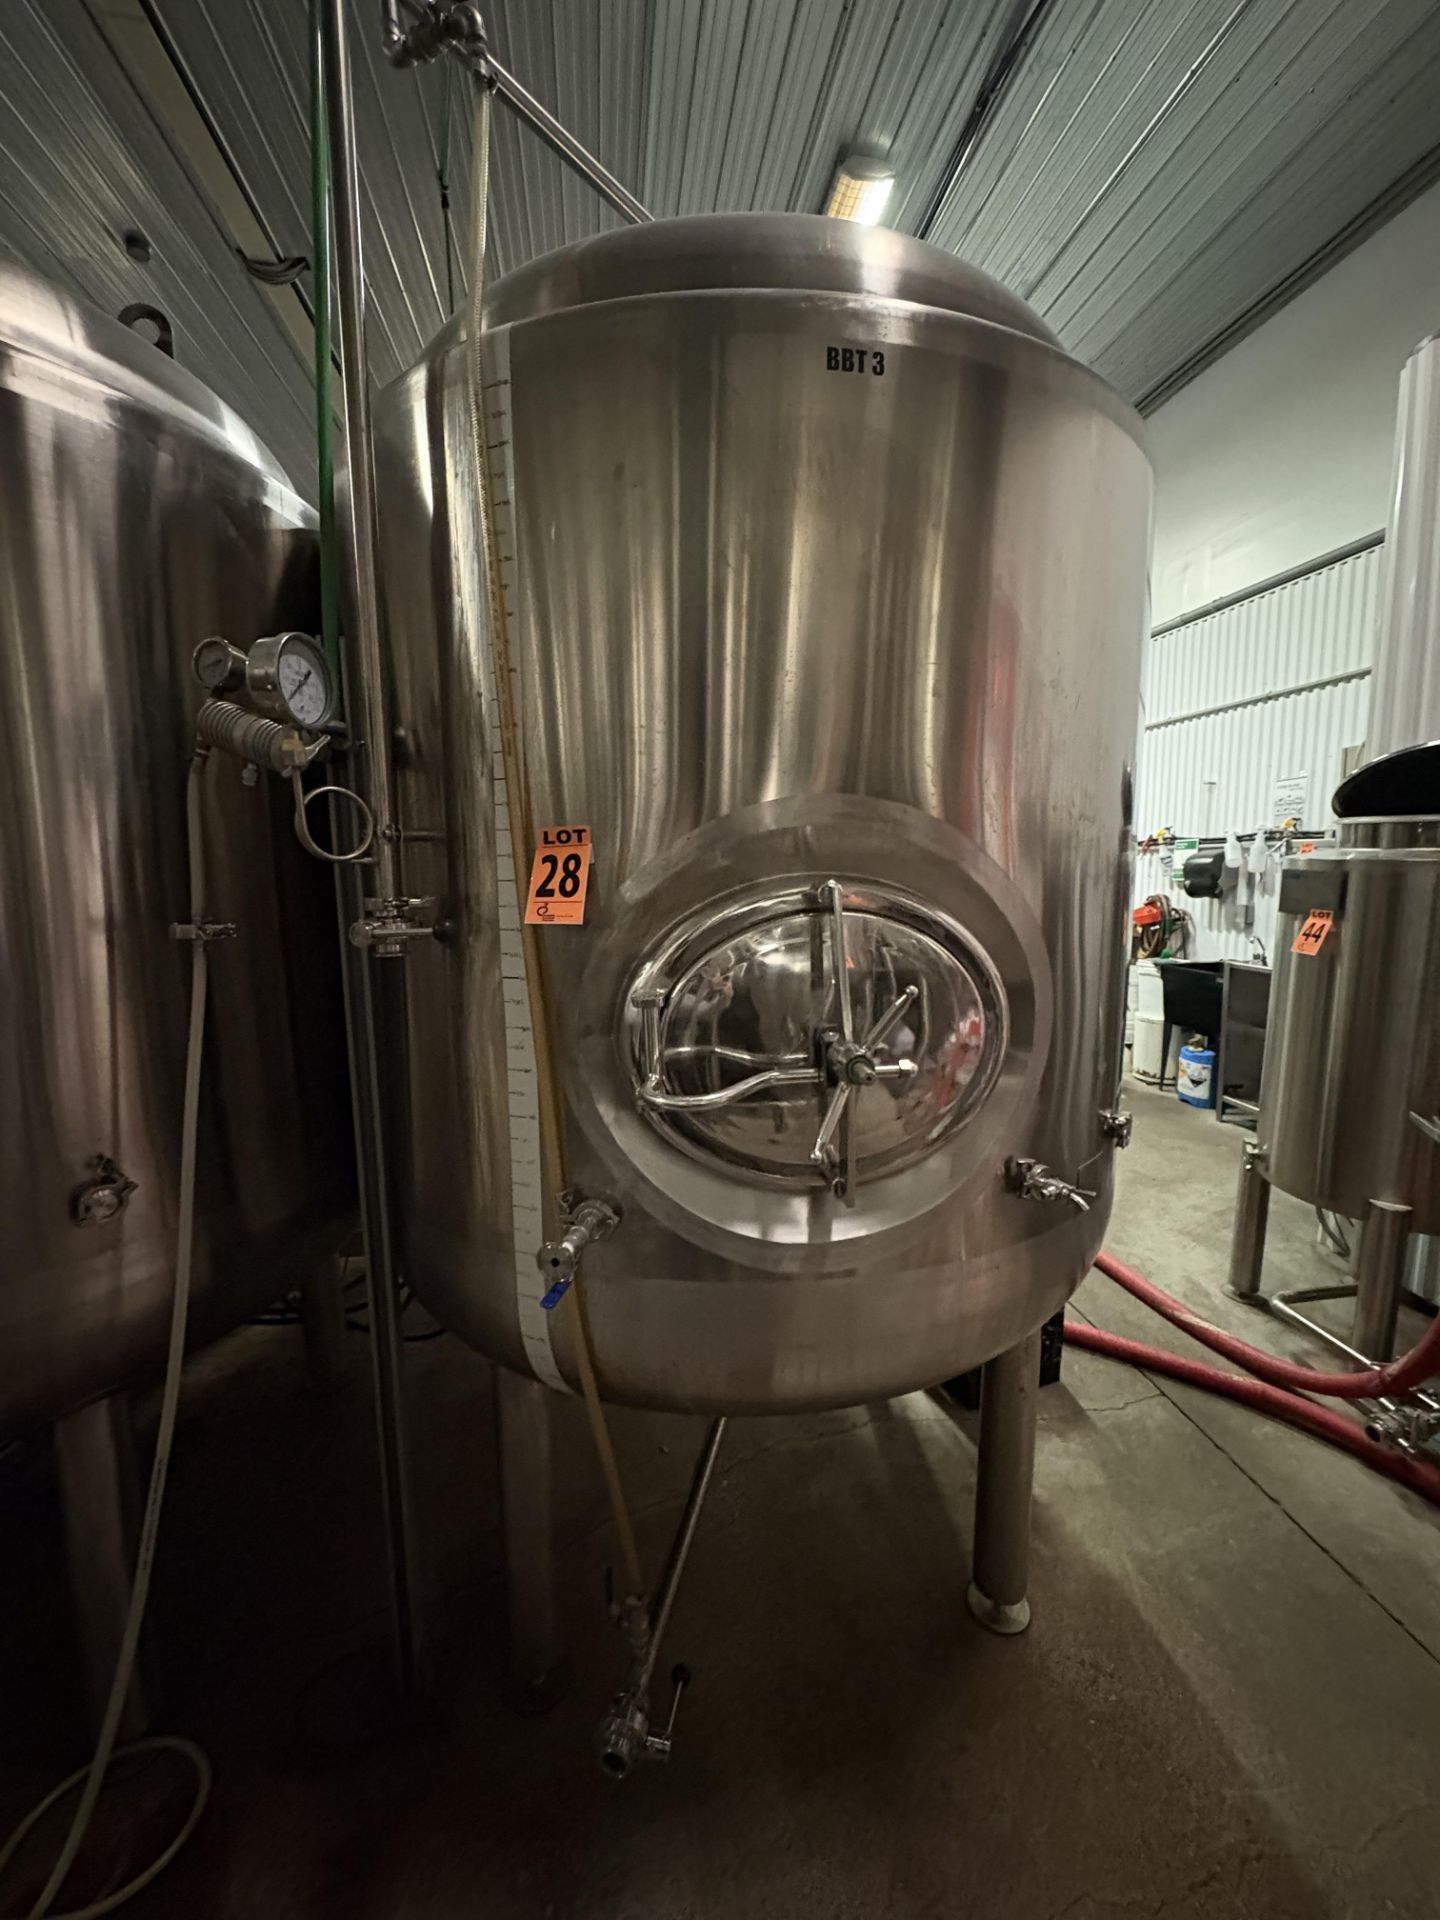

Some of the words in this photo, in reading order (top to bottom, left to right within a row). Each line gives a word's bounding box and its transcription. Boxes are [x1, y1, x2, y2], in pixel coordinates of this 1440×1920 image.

[827, 346, 867, 373] BBT
[872, 351, 885, 376] 3
[543, 829, 586, 845] LOT
[535, 853, 582, 898] 28
[1312, 911, 1331, 919] LOT
[1302, 922, 1326, 943] 44
